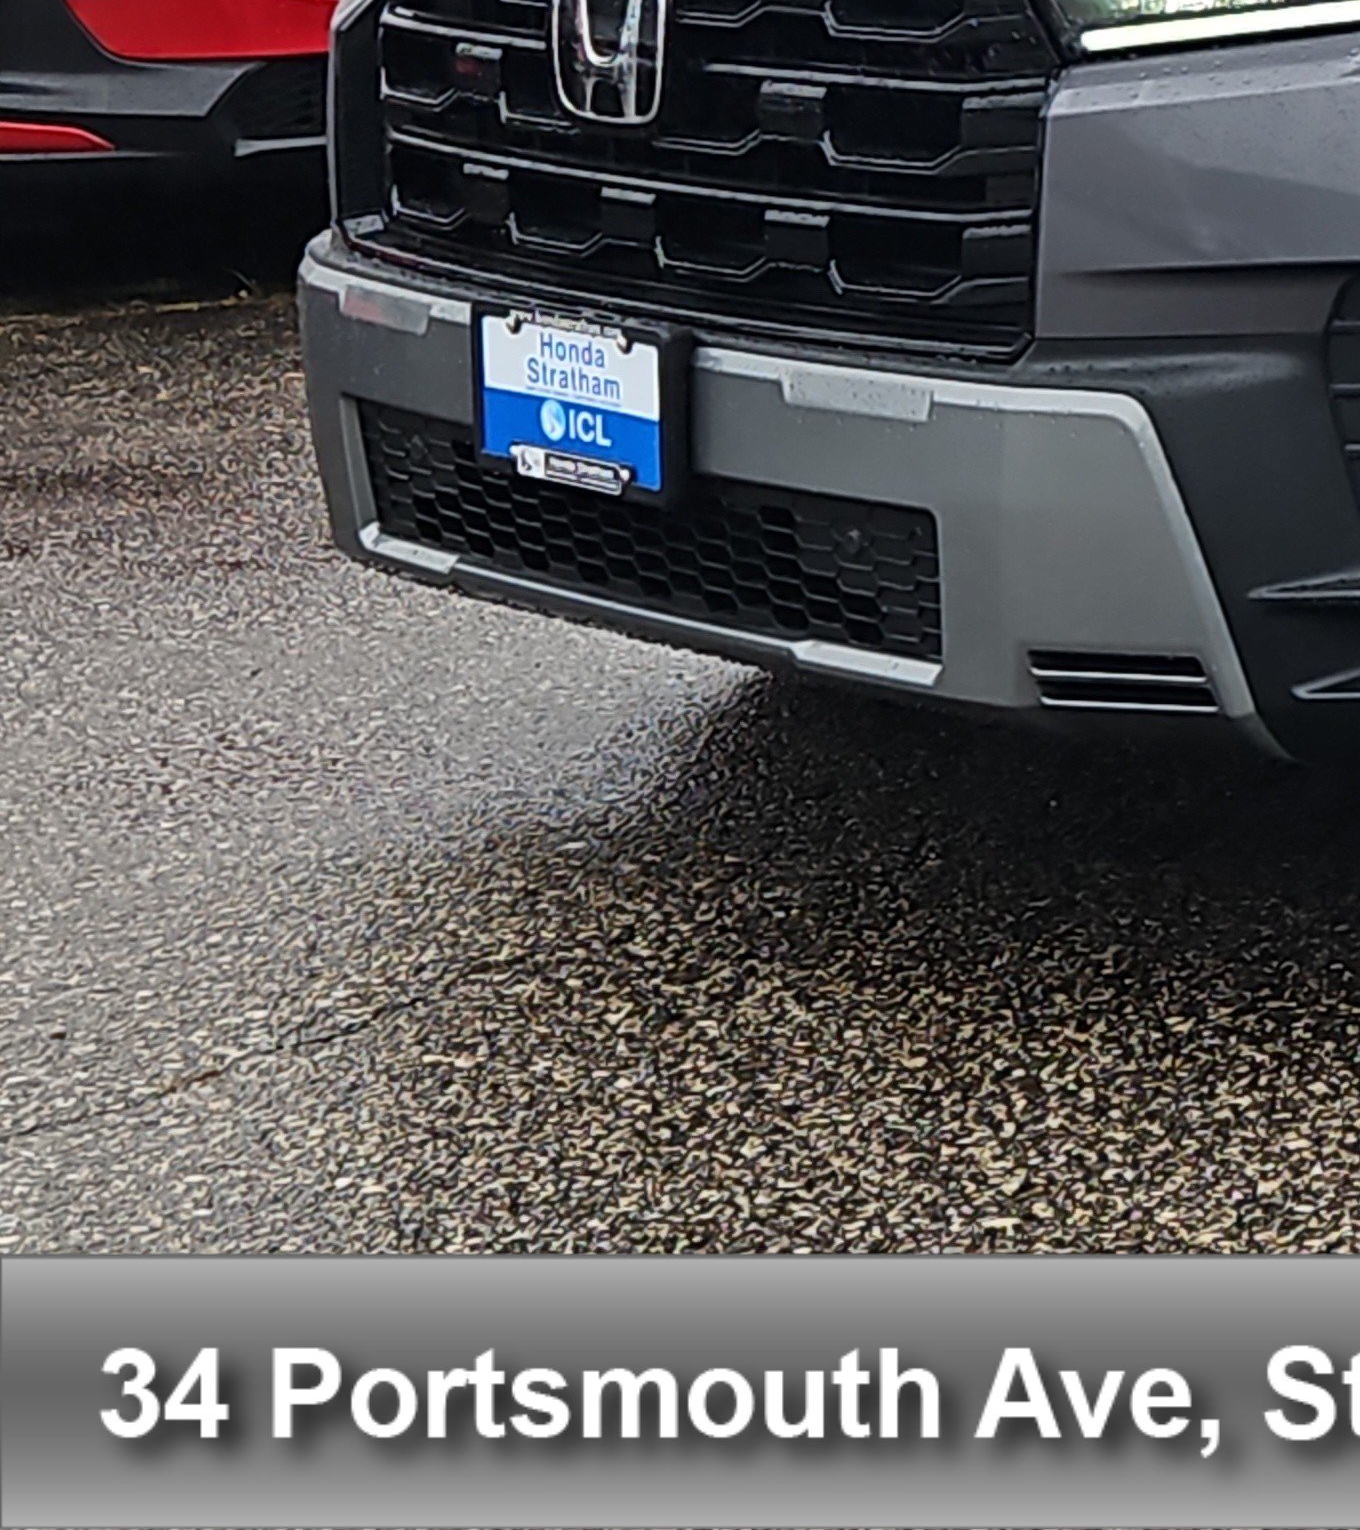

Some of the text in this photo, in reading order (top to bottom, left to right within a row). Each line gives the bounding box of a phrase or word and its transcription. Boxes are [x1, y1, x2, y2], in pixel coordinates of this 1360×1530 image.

[539, 332, 606, 369] Honda
[526, 357, 621, 401] Stratham
[568, 408, 613, 448] ICL
